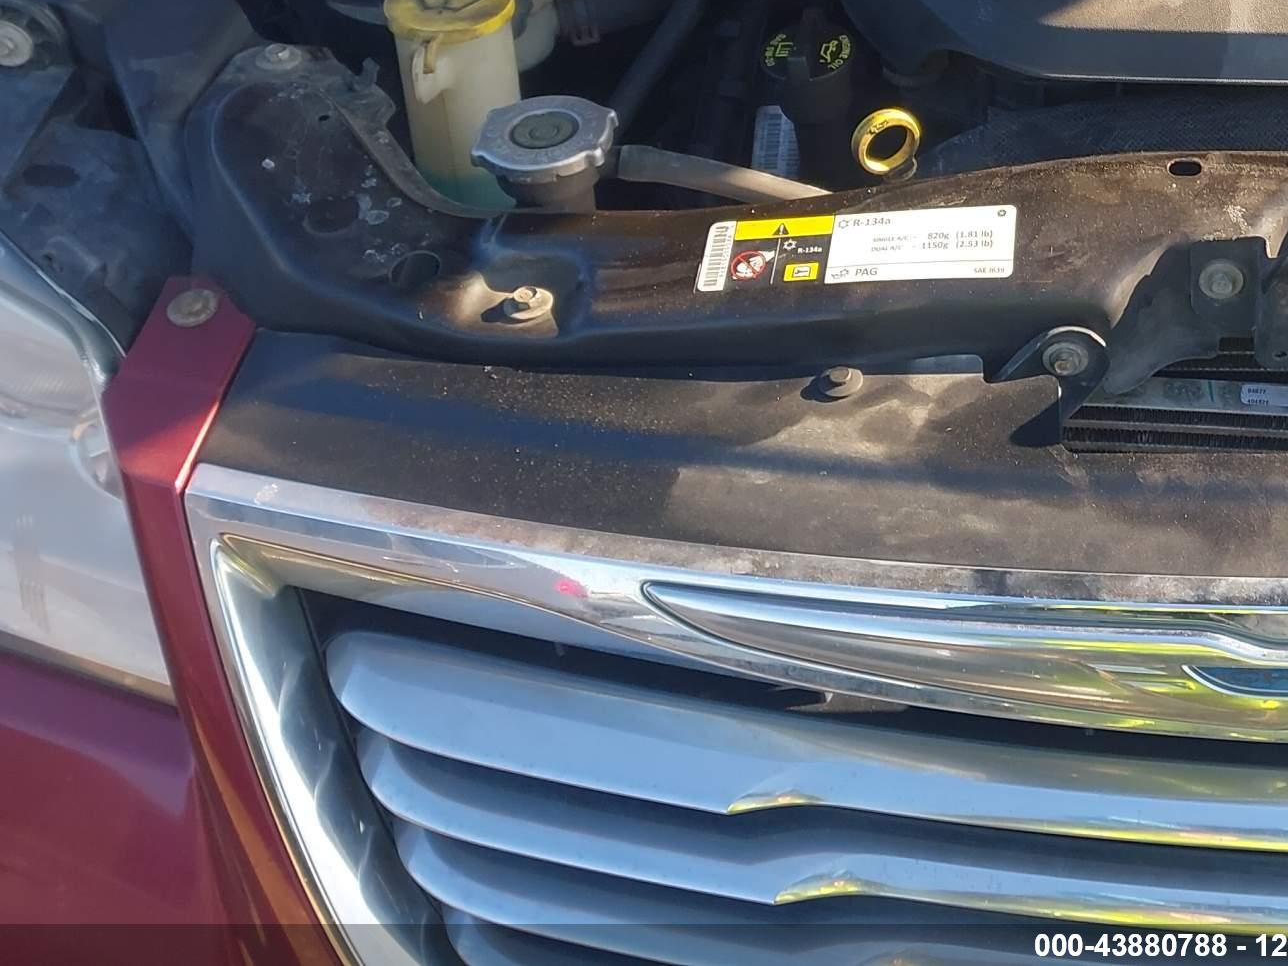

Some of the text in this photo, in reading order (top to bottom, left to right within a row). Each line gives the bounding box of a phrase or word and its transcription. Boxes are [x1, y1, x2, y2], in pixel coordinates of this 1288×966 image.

[853, 217, 891, 227] R-134a
[927, 232, 950, 240] 820g
[956, 230, 978, 239] (1.81
[981, 230, 993, 239] lb)
[922, 241, 949, 250] 1150g
[956, 239, 978, 248] (2.53
[981, 239, 993, 248] lb)
[797, 246, 823, 254] R-134a
[855, 267, 878, 277] PAG
